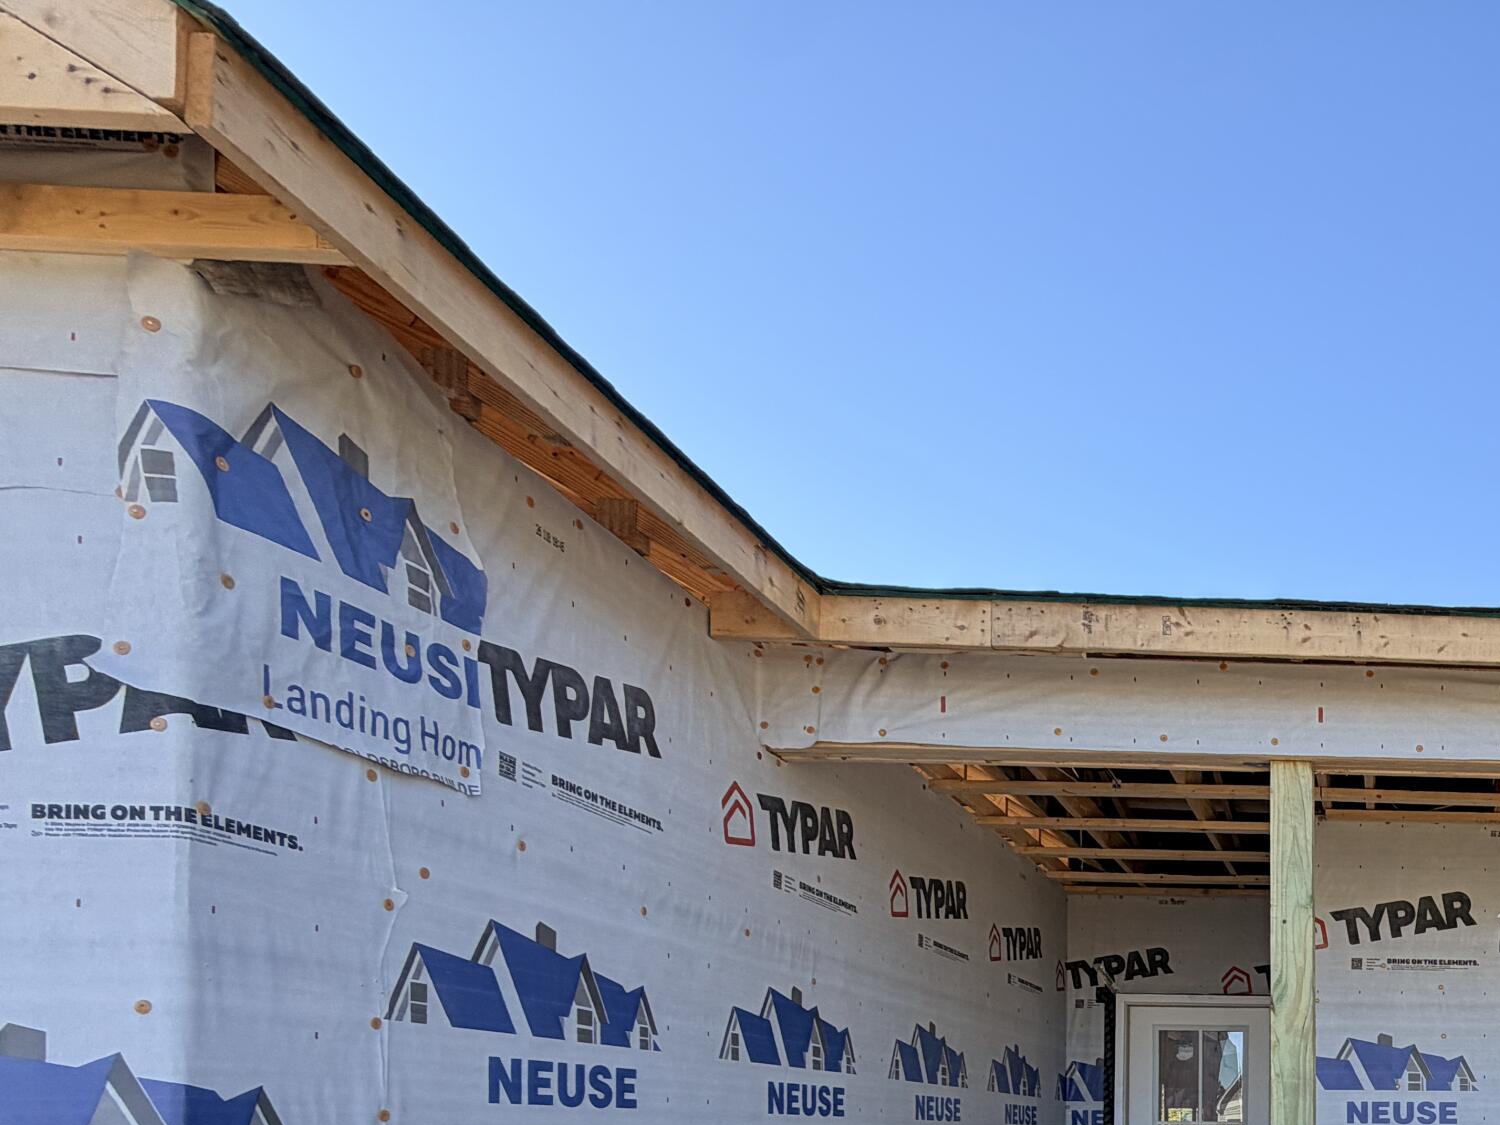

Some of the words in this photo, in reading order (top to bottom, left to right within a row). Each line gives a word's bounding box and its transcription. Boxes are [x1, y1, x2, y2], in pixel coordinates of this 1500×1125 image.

[263, 664, 411, 755] Landing
[478, 640, 662, 758] TYPAR
[551, 774, 583, 796] BRING
[584, 789, 598, 803] ON
[599, 795, 617, 811] THE
[617, 805, 664, 832] ELEMENTS.
[31, 803, 106, 820] BRING
[110, 804, 146, 820] ON
[149, 805, 198, 824] THE
[201, 813, 304, 851] ELEMENTS.
[756, 793, 857, 861] TYPAR
[909, 876, 968, 919] TYPAR
[1329, 891, 1478, 945] TYPAR
[1002, 927, 1043, 961] TYPAR
[1386, 957, 1411, 965] BRING
[1424, 958, 1438, 966] THE
[1065, 947, 1174, 989] TYPAR
[488, 1055, 638, 1109] NEUSE
[767, 1081, 845, 1117] NEUSE
[914, 1094, 961, 1122] NEUSE
[1004, 1103, 1037, 1125] NEUSE
[1346, 1101, 1458, 1125] NEUSE
